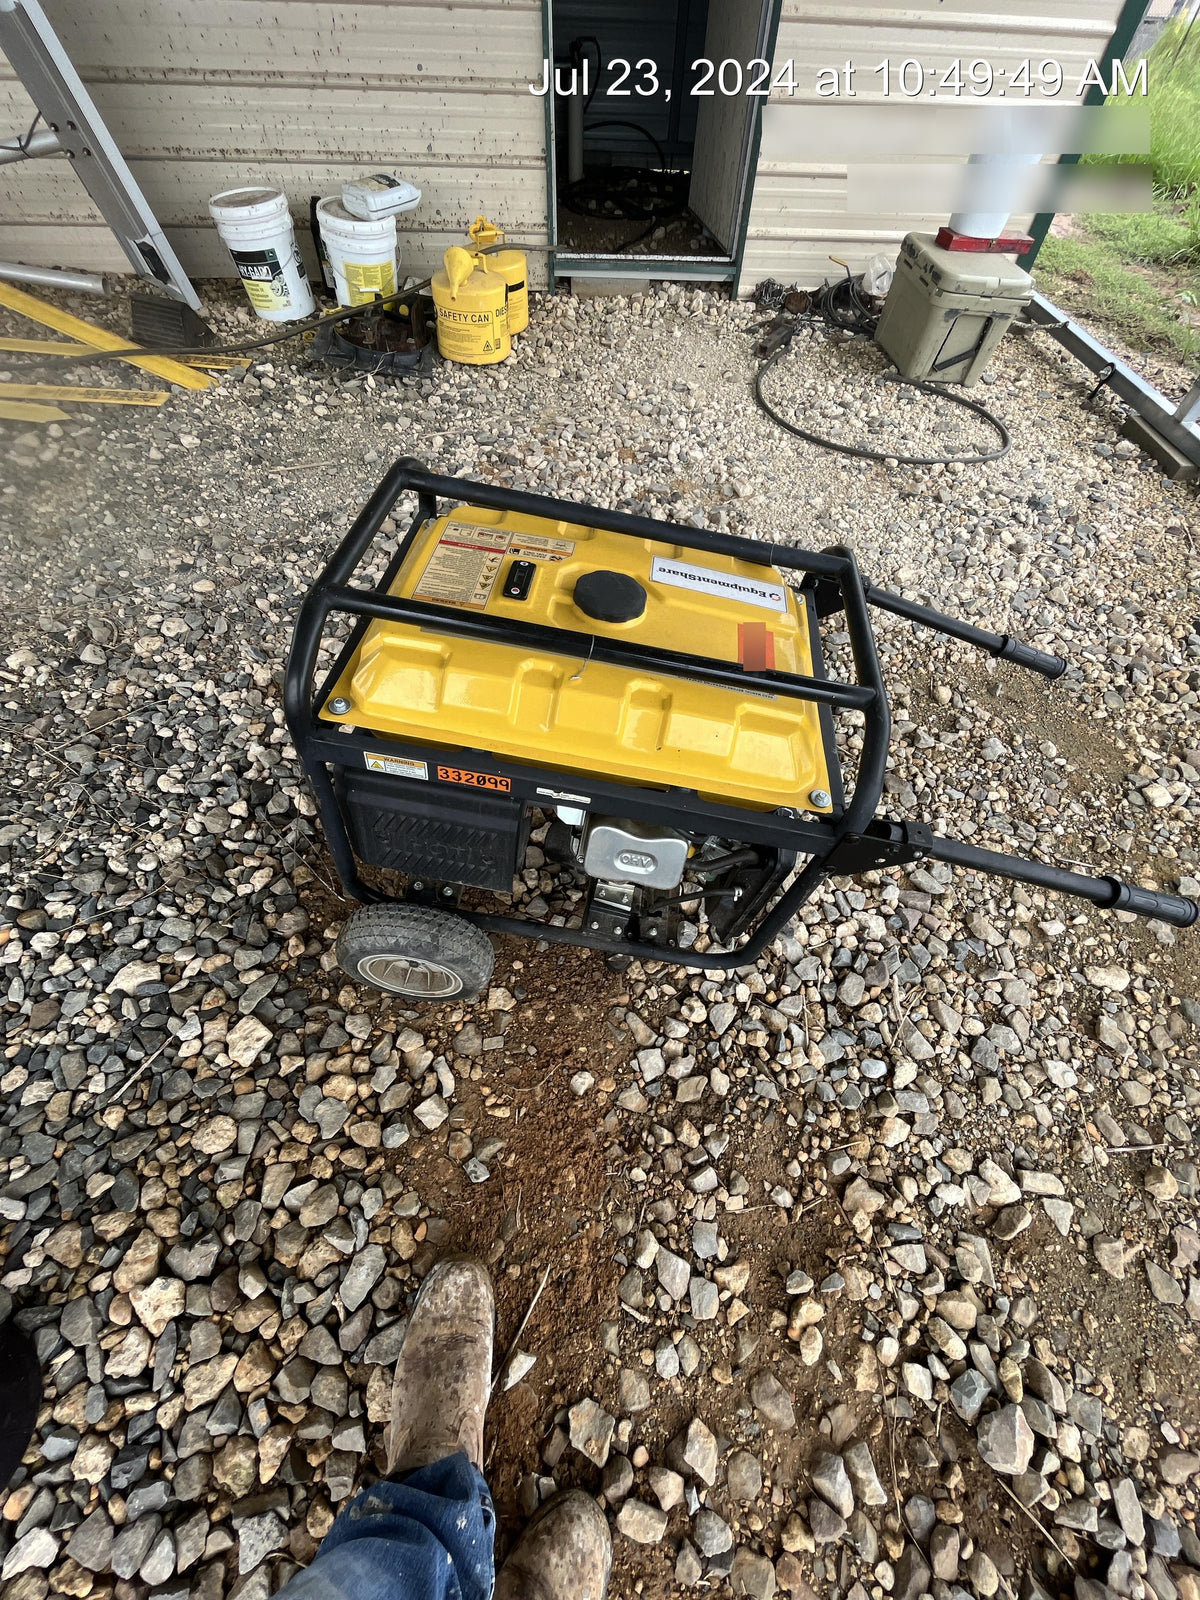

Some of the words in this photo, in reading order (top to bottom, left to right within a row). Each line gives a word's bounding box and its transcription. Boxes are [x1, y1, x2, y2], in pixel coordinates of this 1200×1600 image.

[439, 308, 469, 322] SAFETY
[470, 314, 490, 323] CAN
[658, 567, 767, 598] EquipmentShare
[384, 757, 415, 767] WARNING
[439, 768, 510, 791] 332099
[619, 853, 652, 868] OHV
